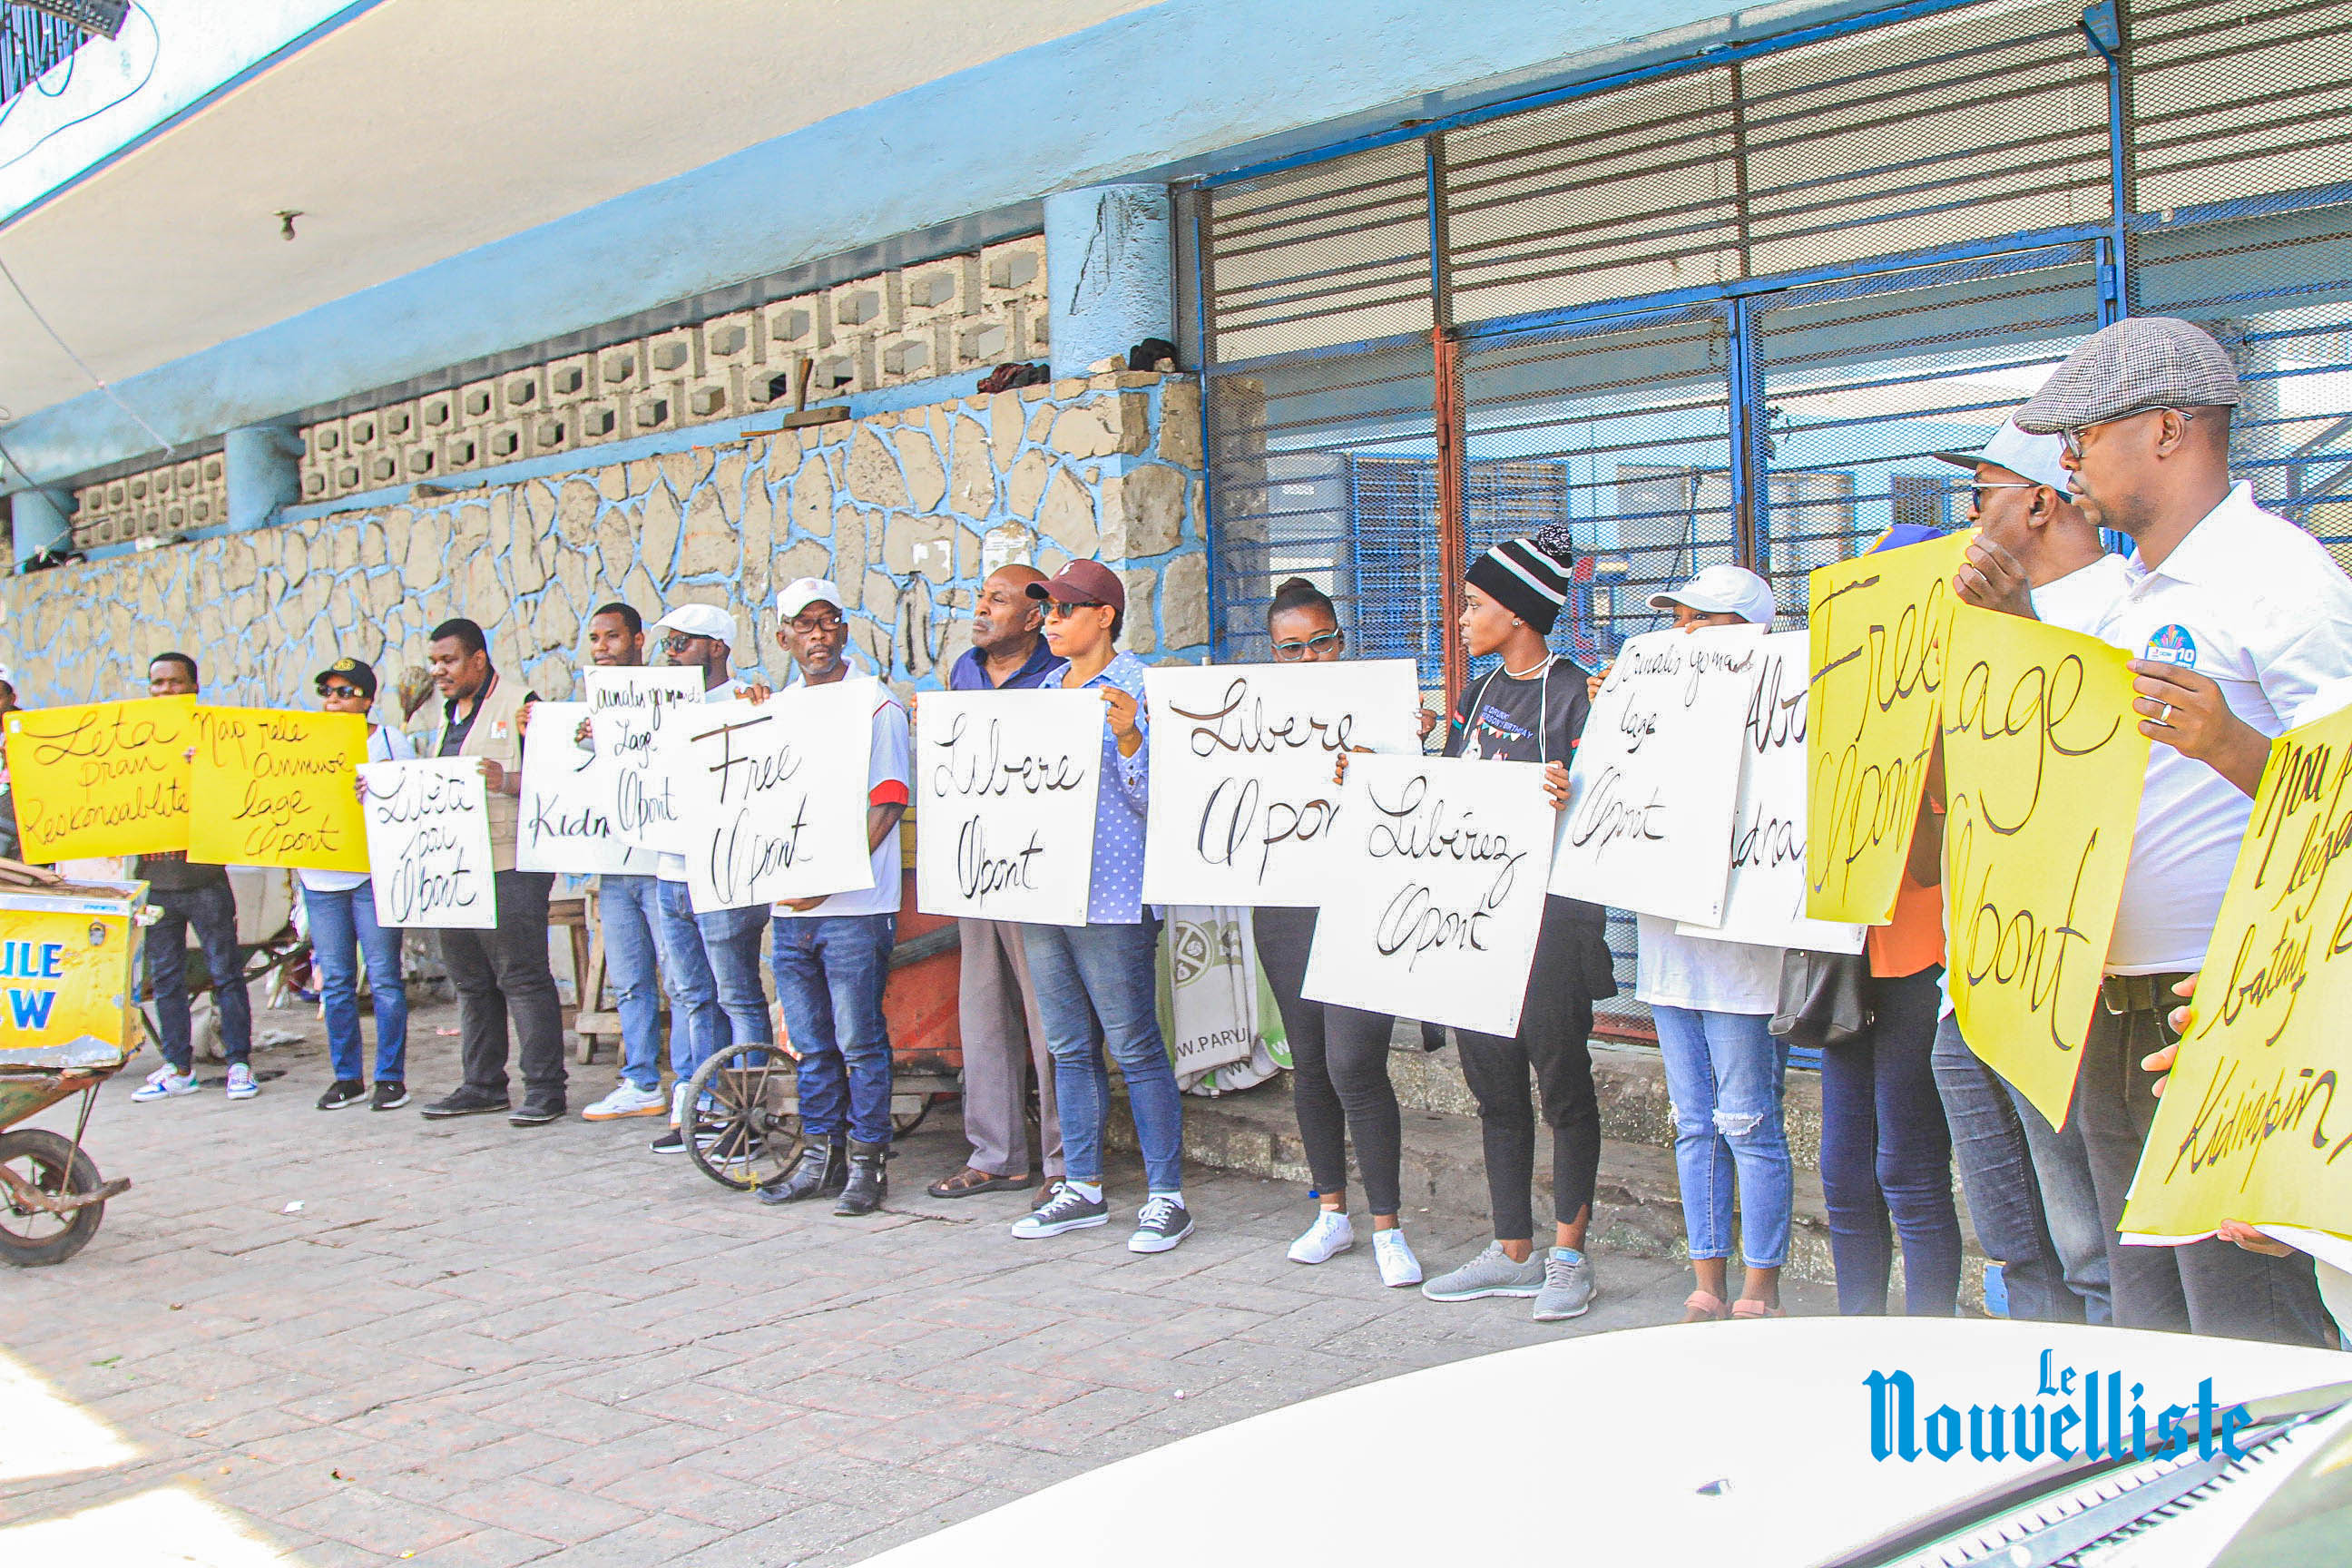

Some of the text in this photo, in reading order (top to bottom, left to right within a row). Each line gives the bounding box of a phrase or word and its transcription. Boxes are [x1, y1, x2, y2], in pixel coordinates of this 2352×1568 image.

[24, 704, 181, 766] Leta
[691, 716, 804, 804] Free
[935, 712, 1085, 797] Libere
[529, 791, 612, 849] Kidn
